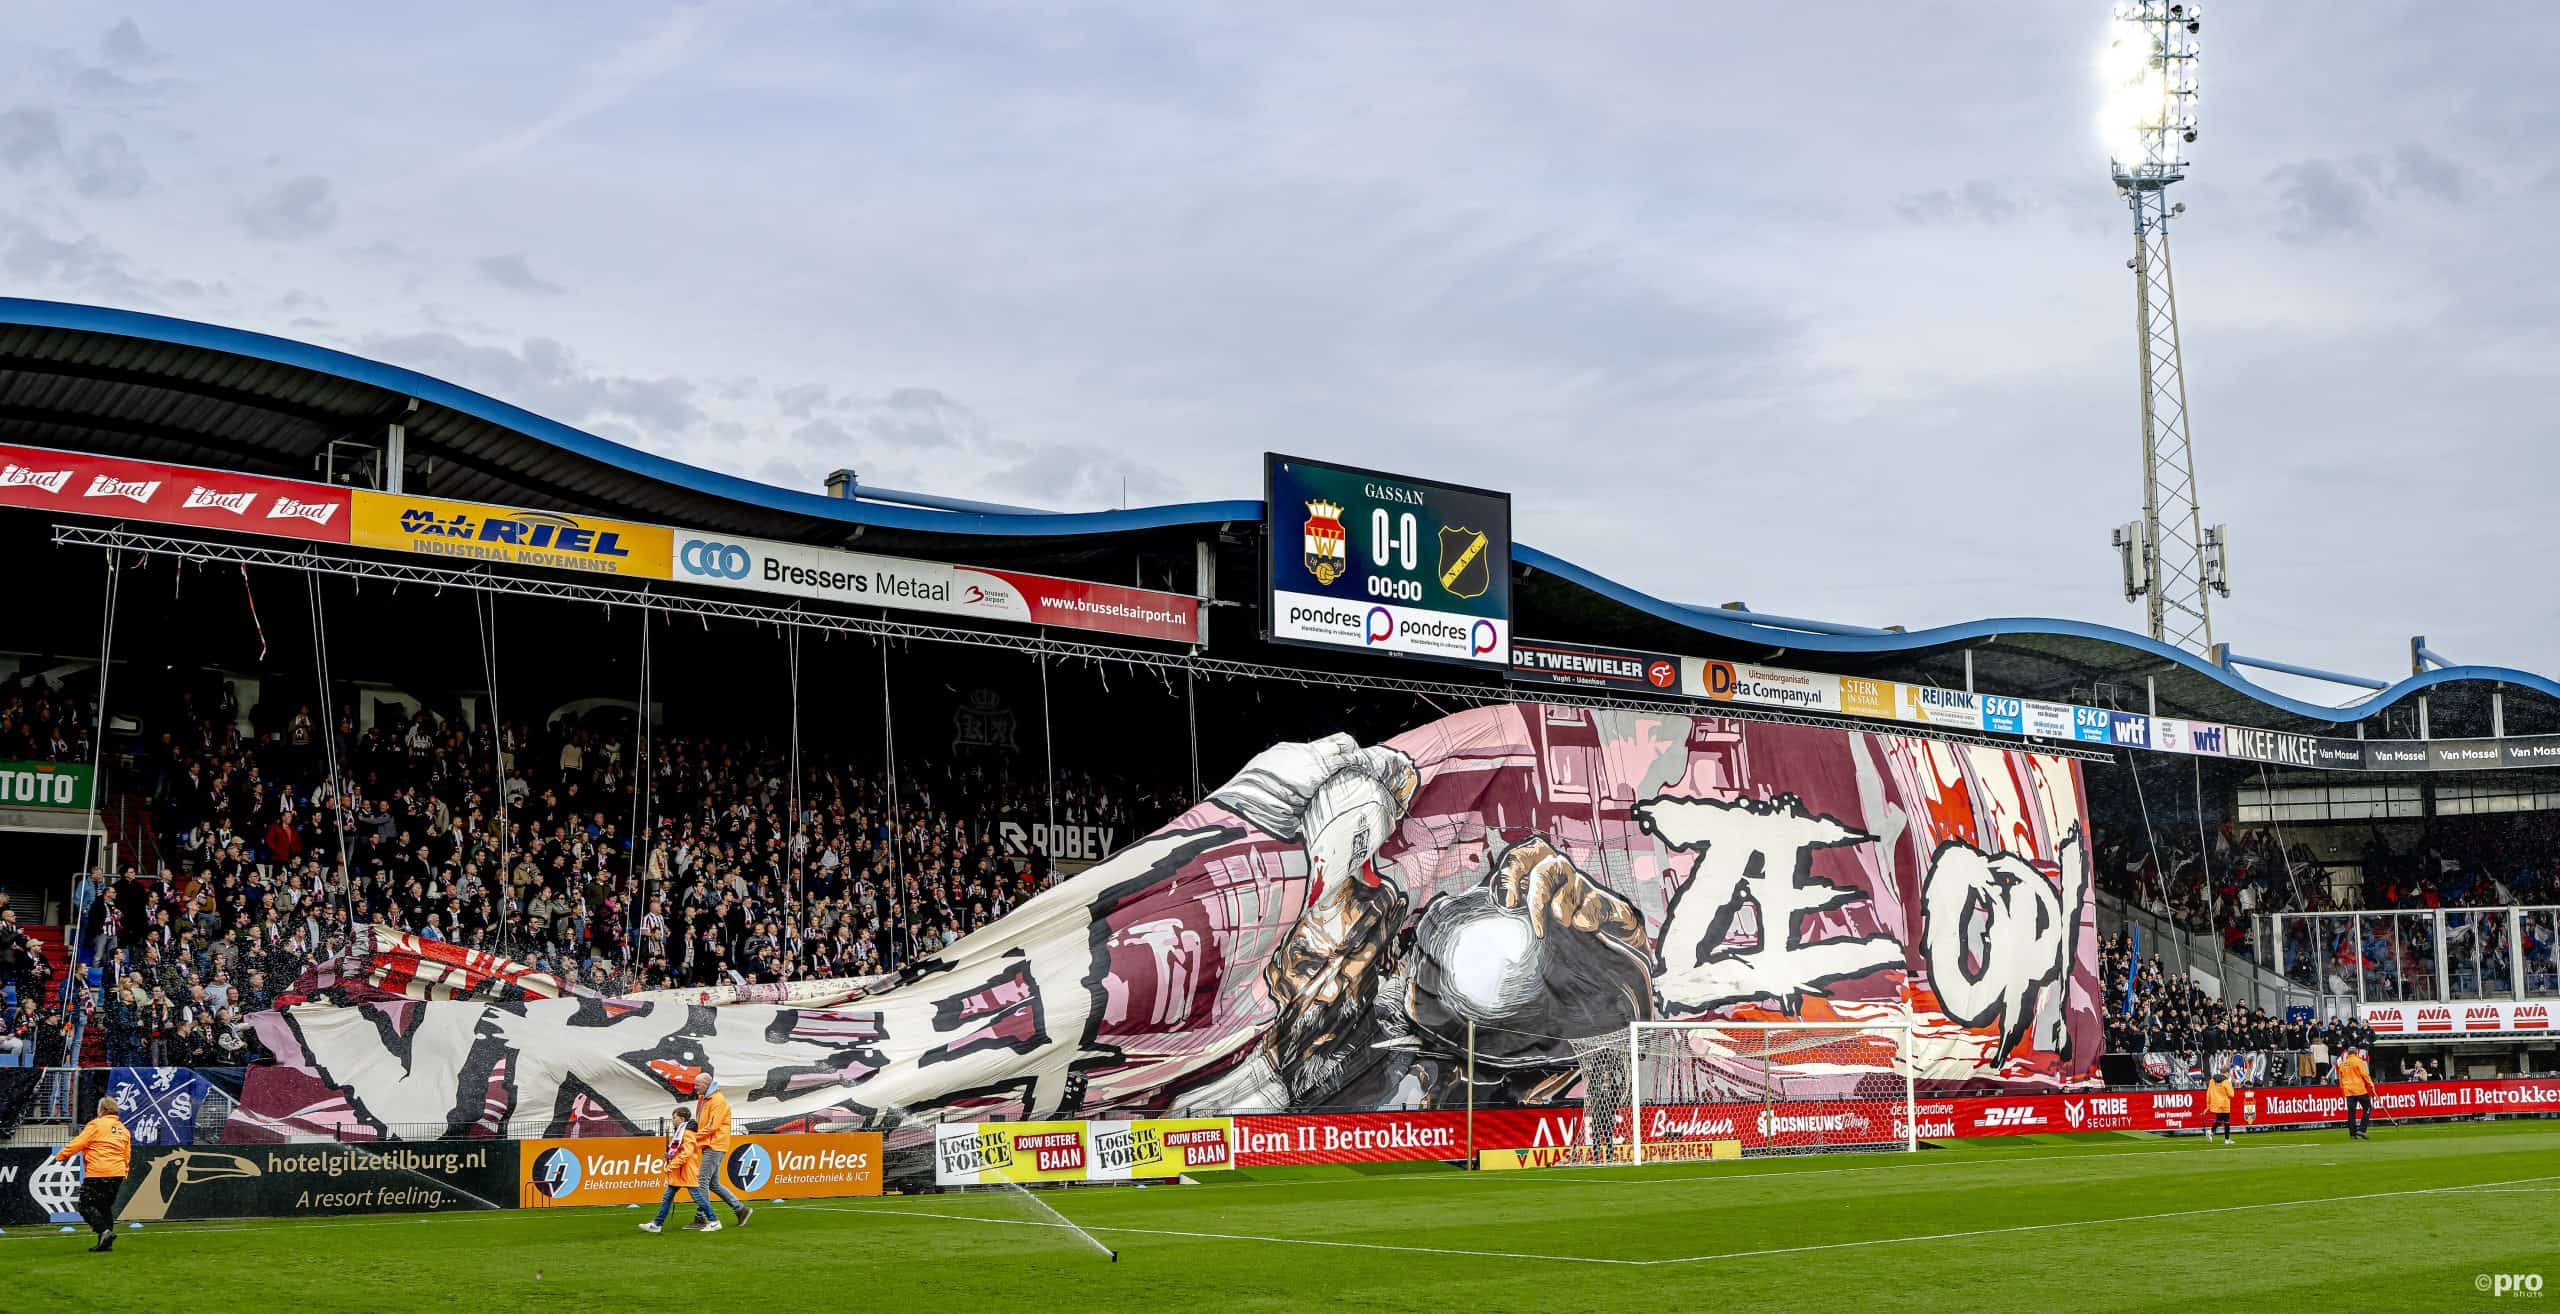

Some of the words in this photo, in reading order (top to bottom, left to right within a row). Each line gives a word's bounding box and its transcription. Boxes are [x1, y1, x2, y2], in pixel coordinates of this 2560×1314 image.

[3, 464, 59, 487] Bud
[94, 475, 147, 497] Bud
[192, 486, 243, 508] Bud
[1364, 483, 1425, 506] GASSAN
[277, 497, 327, 519] Bud
[400, 521, 475, 539] VAN
[479, 518, 629, 557] RIEL
[1372, 508, 1417, 571] 0-0
[413, 539, 512, 562] INDUSTRIAL
[516, 551, 617, 573] MOVEMENTS
[763, 557, 868, 593] Bressers
[876, 572, 950, 601] Metaal
[1367, 575, 1423, 602] 00:00
[1040, 596, 1187, 625] www.brusselsairport.nl
[1290, 606, 1361, 628] pondres
[1400, 620, 1467, 640] pondres
[1512, 649, 1534, 666] DE
[1535, 652, 1643, 677] TWEEWIELER
[1711, 664, 1750, 696] Deta
[1753, 682, 1822, 706] Company.nl
[1748, 670, 1810, 685] Uitzendorganisatie
[1847, 679, 1878, 696] STERK
[1922, 687, 1974, 709] REIJRINK
[1986, 698, 2019, 717] SKD
[2077, 709, 2108, 728] SKD
[2114, 717, 2145, 745] wtf
[2193, 727, 2221, 752] wtf
[2320, 748, 2333, 759] Van
[2335, 749, 2359, 760] Mossel
[2376, 751, 2393, 760] Van
[2394, 751, 2426, 761] Mossel
[2440, 750, 2460, 760] Van
[2462, 748, 2498, 760] Mossel
[2510, 747, 2530, 757] Van
[0, 770, 74, 804] TOTO
[1033, 823, 1114, 859] ROBEY
[2369, 1008, 2402, 1021] AVIA
[2417, 1006, 2451, 1020] AVIA
[2465, 1005, 2500, 1019] AVIA
[2514, 1004, 2548, 1018] AVIA
[2090, 1098, 2128, 1115] TRIBE
[2152, 1094, 2193, 1108] JUMBO
[2418, 1088, 2457, 1107] Willem
[2460, 1088, 2471, 1105] II
[2474, 1086, 2560, 1104] Betrokke
[1983, 1106, 2042, 1126] DHL
[2087, 1117, 2132, 1128] SECURITY
[1167, 1133, 1190, 1145] JOUW
[1192, 1131, 1221, 1143] BETERE
[1234, 1127, 1290, 1153] llem
[1297, 1126, 1317, 1150] II
[1324, 1122, 1454, 1149] Betrokken:
[1894, 1118, 1955, 1138] Raobank
[941, 1131, 1007, 1156] LOGISTIC
[1017, 1135, 1043, 1149] JOUW
[1045, 1133, 1077, 1147] BETERE
[1097, 1128, 1156, 1151] LOGISTIC
[268, 1149, 487, 1177] hotelgilzetilburg.nl
[777, 1151, 818, 1171] Van
[820, 1150, 867, 1169] Hees
[944, 1143, 1011, 1174] FORCE
[1040, 1149, 1081, 1170] BAAN
[1099, 1140, 1160, 1169] FORCE
[1188, 1143, 1226, 1165] BAAN
[587, 1156, 629, 1176] Van
[584, 1177, 661, 1190] Elektrotechniek
[774, 1172, 844, 1185] Elektrotechniek
[846, 1173, 853, 1181] &
[855, 1171, 871, 1181] ICT
[296, 1191, 310, 1208] A
[314, 1189, 373, 1207] resort
[377, 1187, 457, 1209] feeling...
